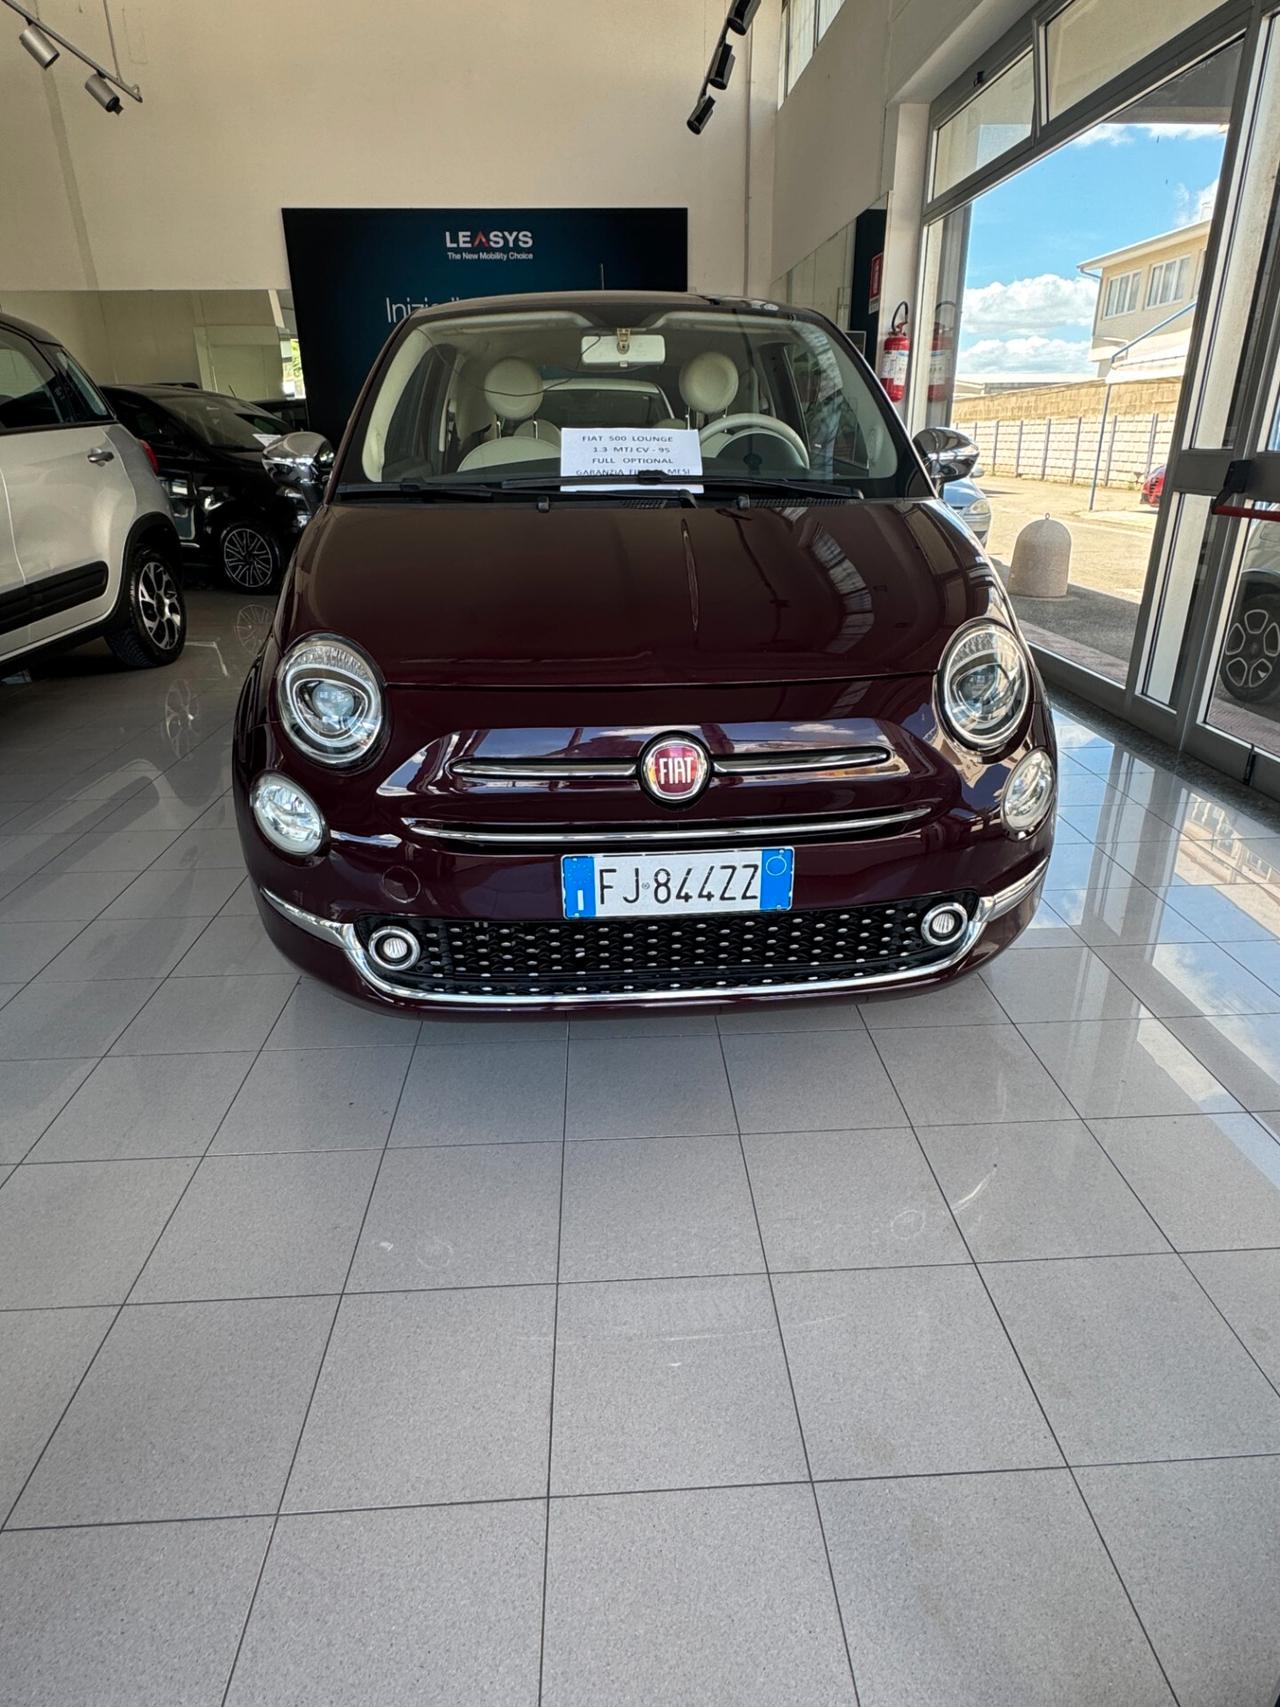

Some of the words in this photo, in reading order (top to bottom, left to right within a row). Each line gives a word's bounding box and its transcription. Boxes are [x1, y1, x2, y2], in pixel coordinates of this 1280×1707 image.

[445, 231, 534, 248] LEASYS
[447, 252, 461, 260] The
[462, 252, 478, 260] New
[480, 252, 508, 261] Mobility
[508, 251, 534, 260] Choice
[631, 435, 673, 443] LOUNGE
[635, 446, 649, 454] CV
[658, 756, 695, 785] FIAT
